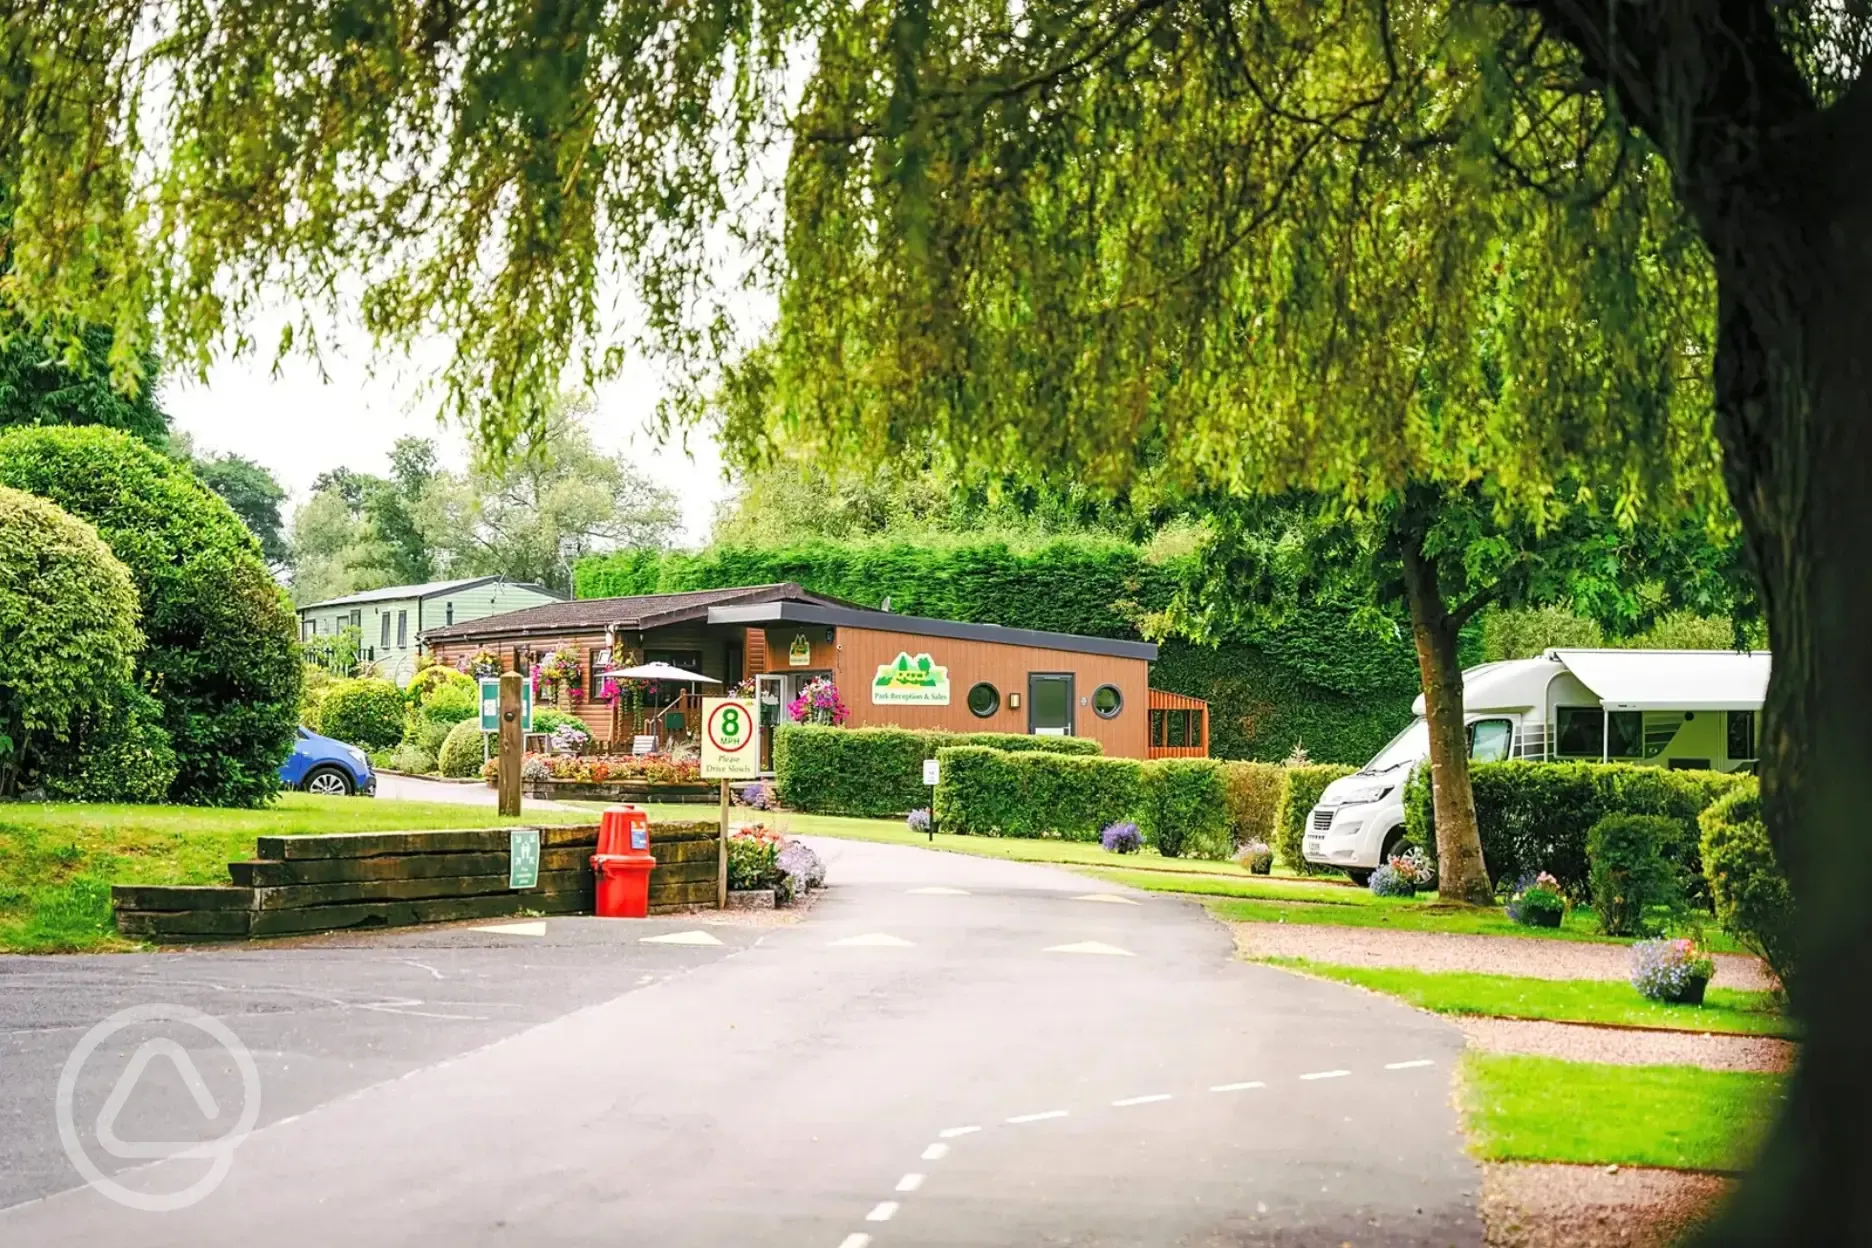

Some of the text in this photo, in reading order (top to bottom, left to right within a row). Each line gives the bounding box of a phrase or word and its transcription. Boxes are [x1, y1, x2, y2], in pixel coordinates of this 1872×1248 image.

[874, 692, 889, 700] Park
[890, 692, 922, 702] Reception
[931, 692, 947, 700] Sales
[721, 708, 740, 736] 8
[720, 737, 740, 745] MPH
[718, 755, 740, 763] Please
[706, 764, 751, 774] Drive Slowly
